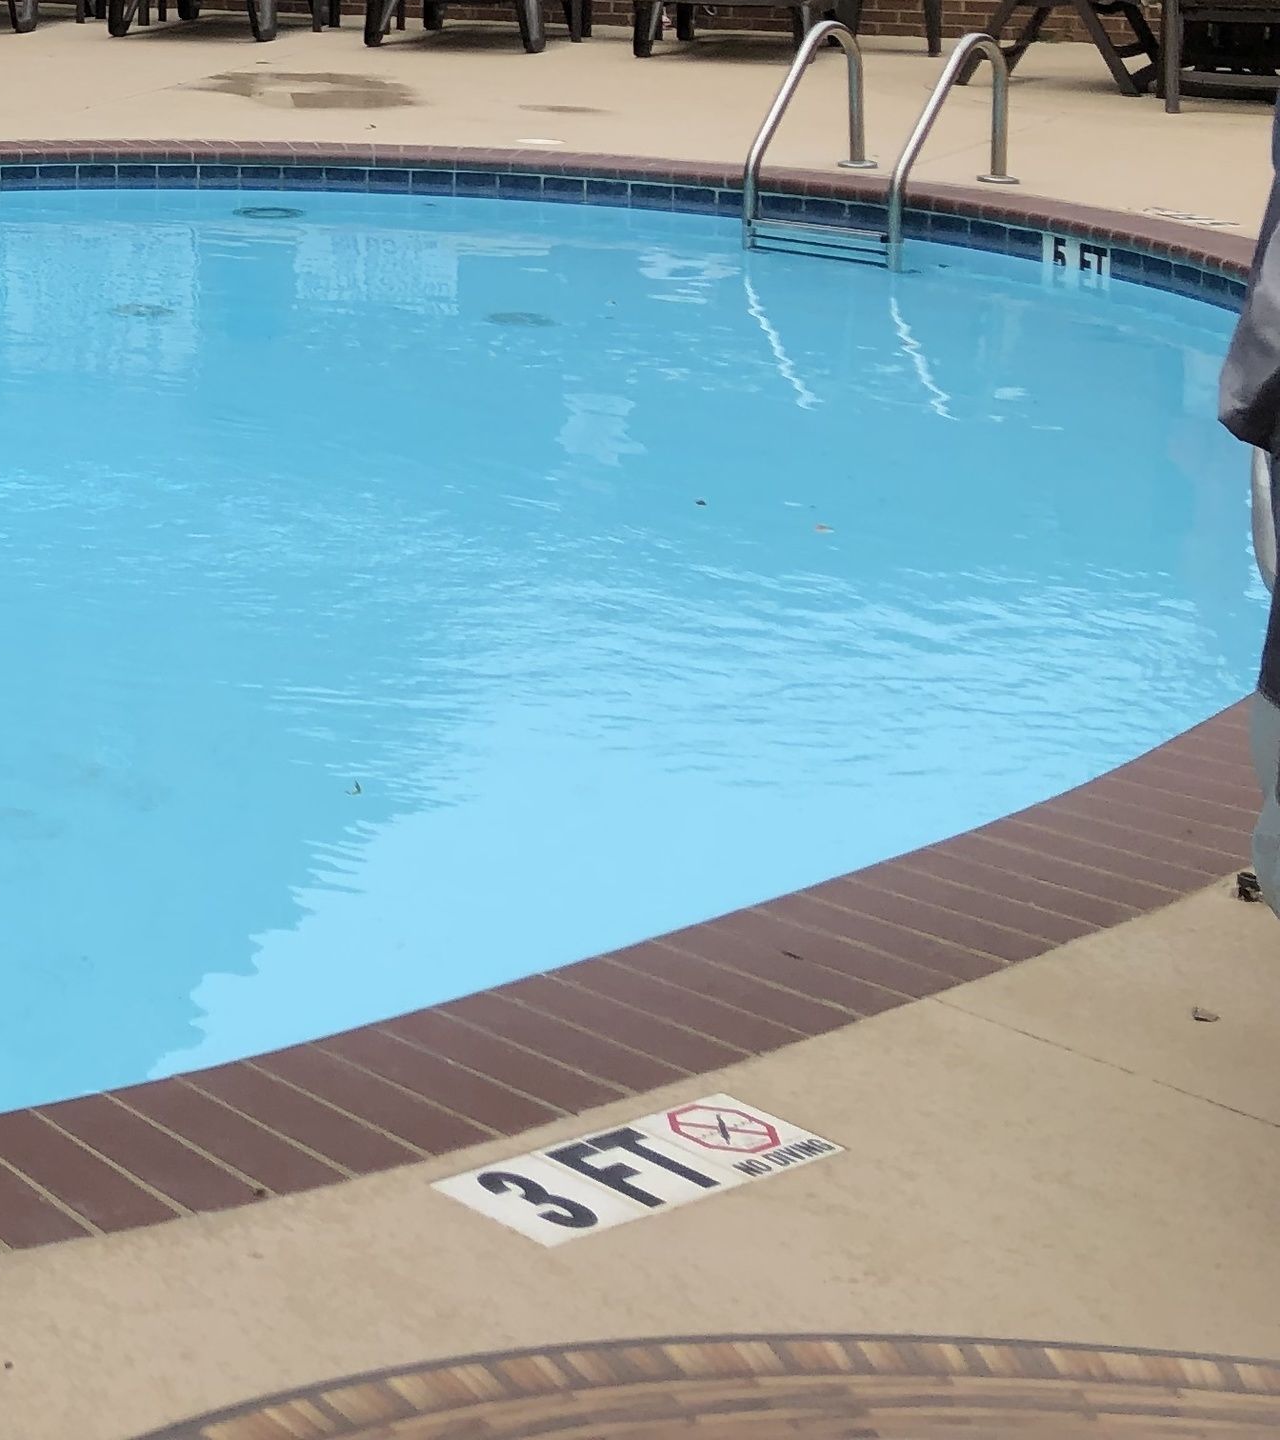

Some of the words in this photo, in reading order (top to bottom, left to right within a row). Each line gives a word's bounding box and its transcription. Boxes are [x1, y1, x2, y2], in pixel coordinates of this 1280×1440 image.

[1054, 237, 1066, 266] 5
[1080, 243, 1108, 275] FT
[477, 1171, 598, 1229] 3
[544, 1126, 722, 1208] FT
[733, 1158, 773, 1178] NO
[771, 1138, 836, 1170] DIVING
